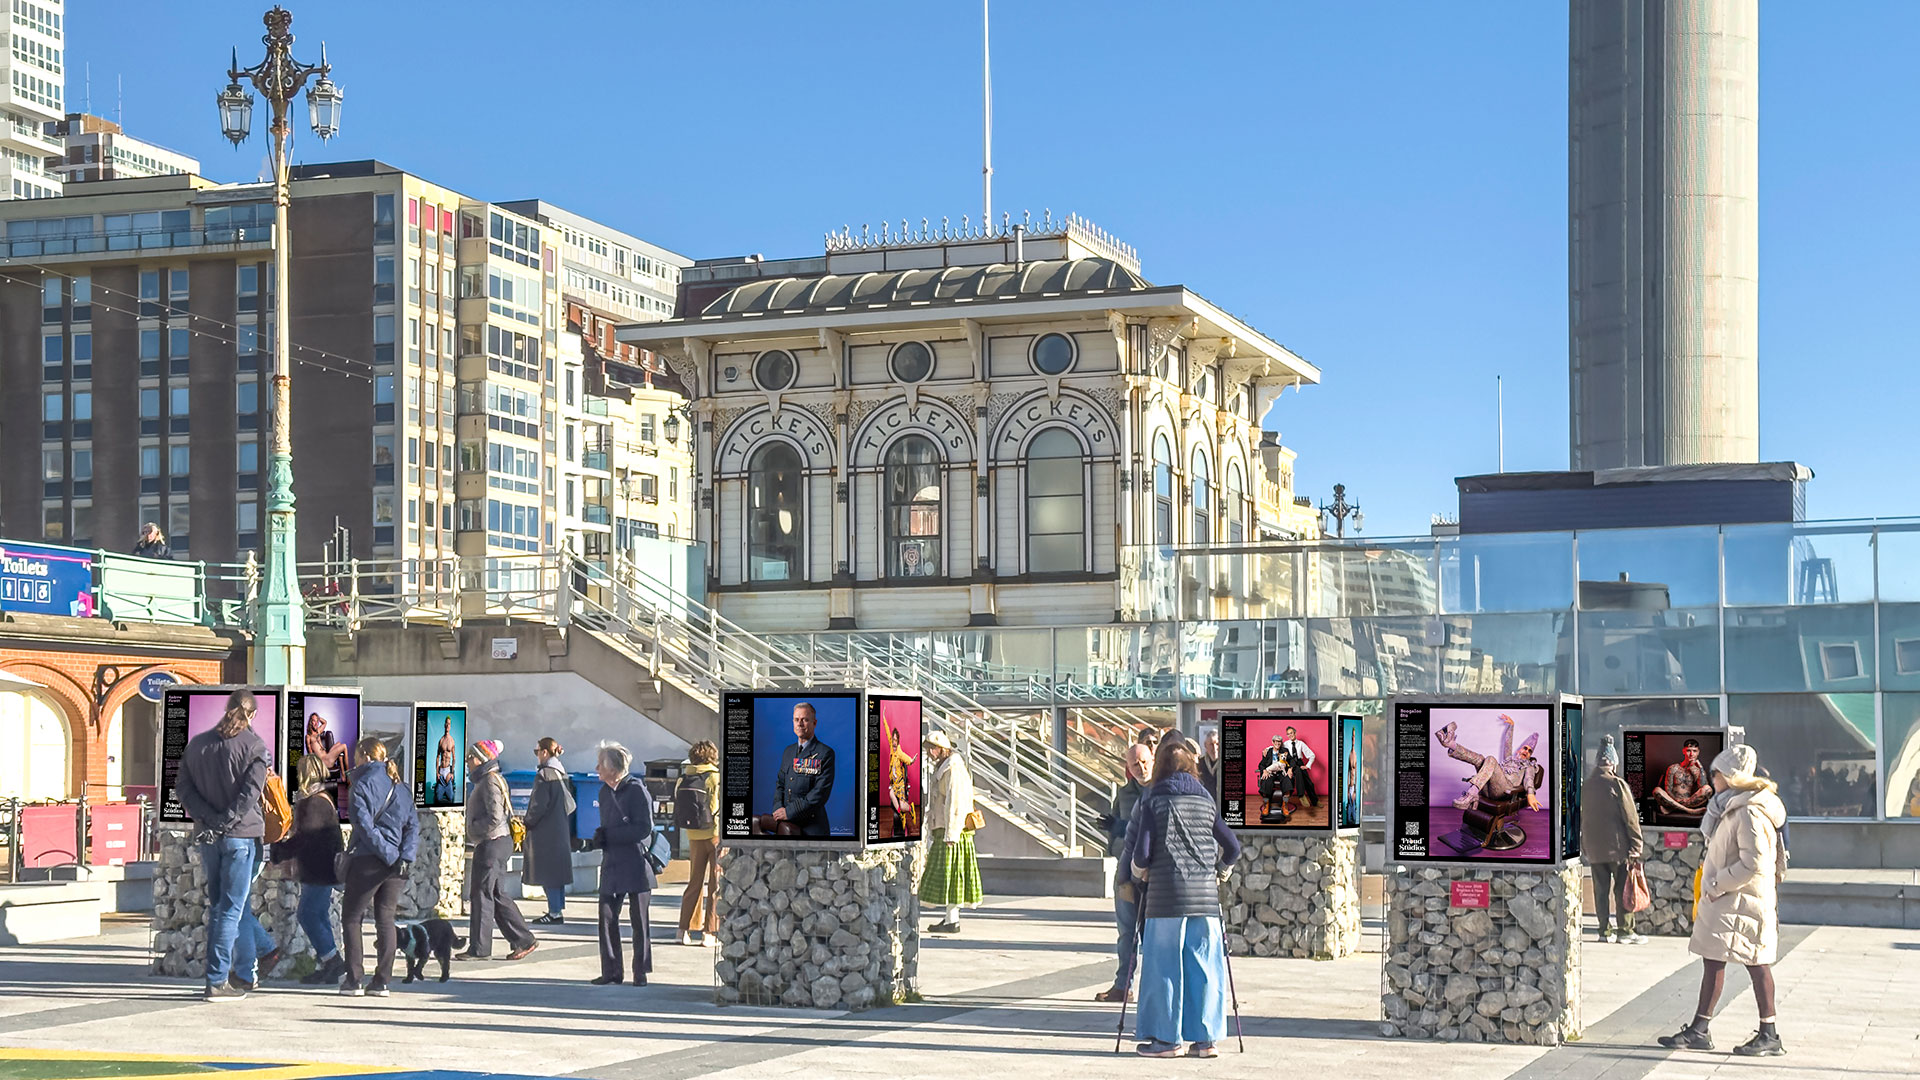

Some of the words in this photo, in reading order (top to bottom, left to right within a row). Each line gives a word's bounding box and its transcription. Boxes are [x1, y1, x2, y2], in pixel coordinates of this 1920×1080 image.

[728, 414, 825, 456] TICKETS
[864, 407, 963, 449] TICKETS
[1004, 400, 1106, 443] TICKETS
[1, 557, 48, 576] Toilets
[1398, 844, 1426, 852] Studios
[1400, 837, 1424, 845] Proud
